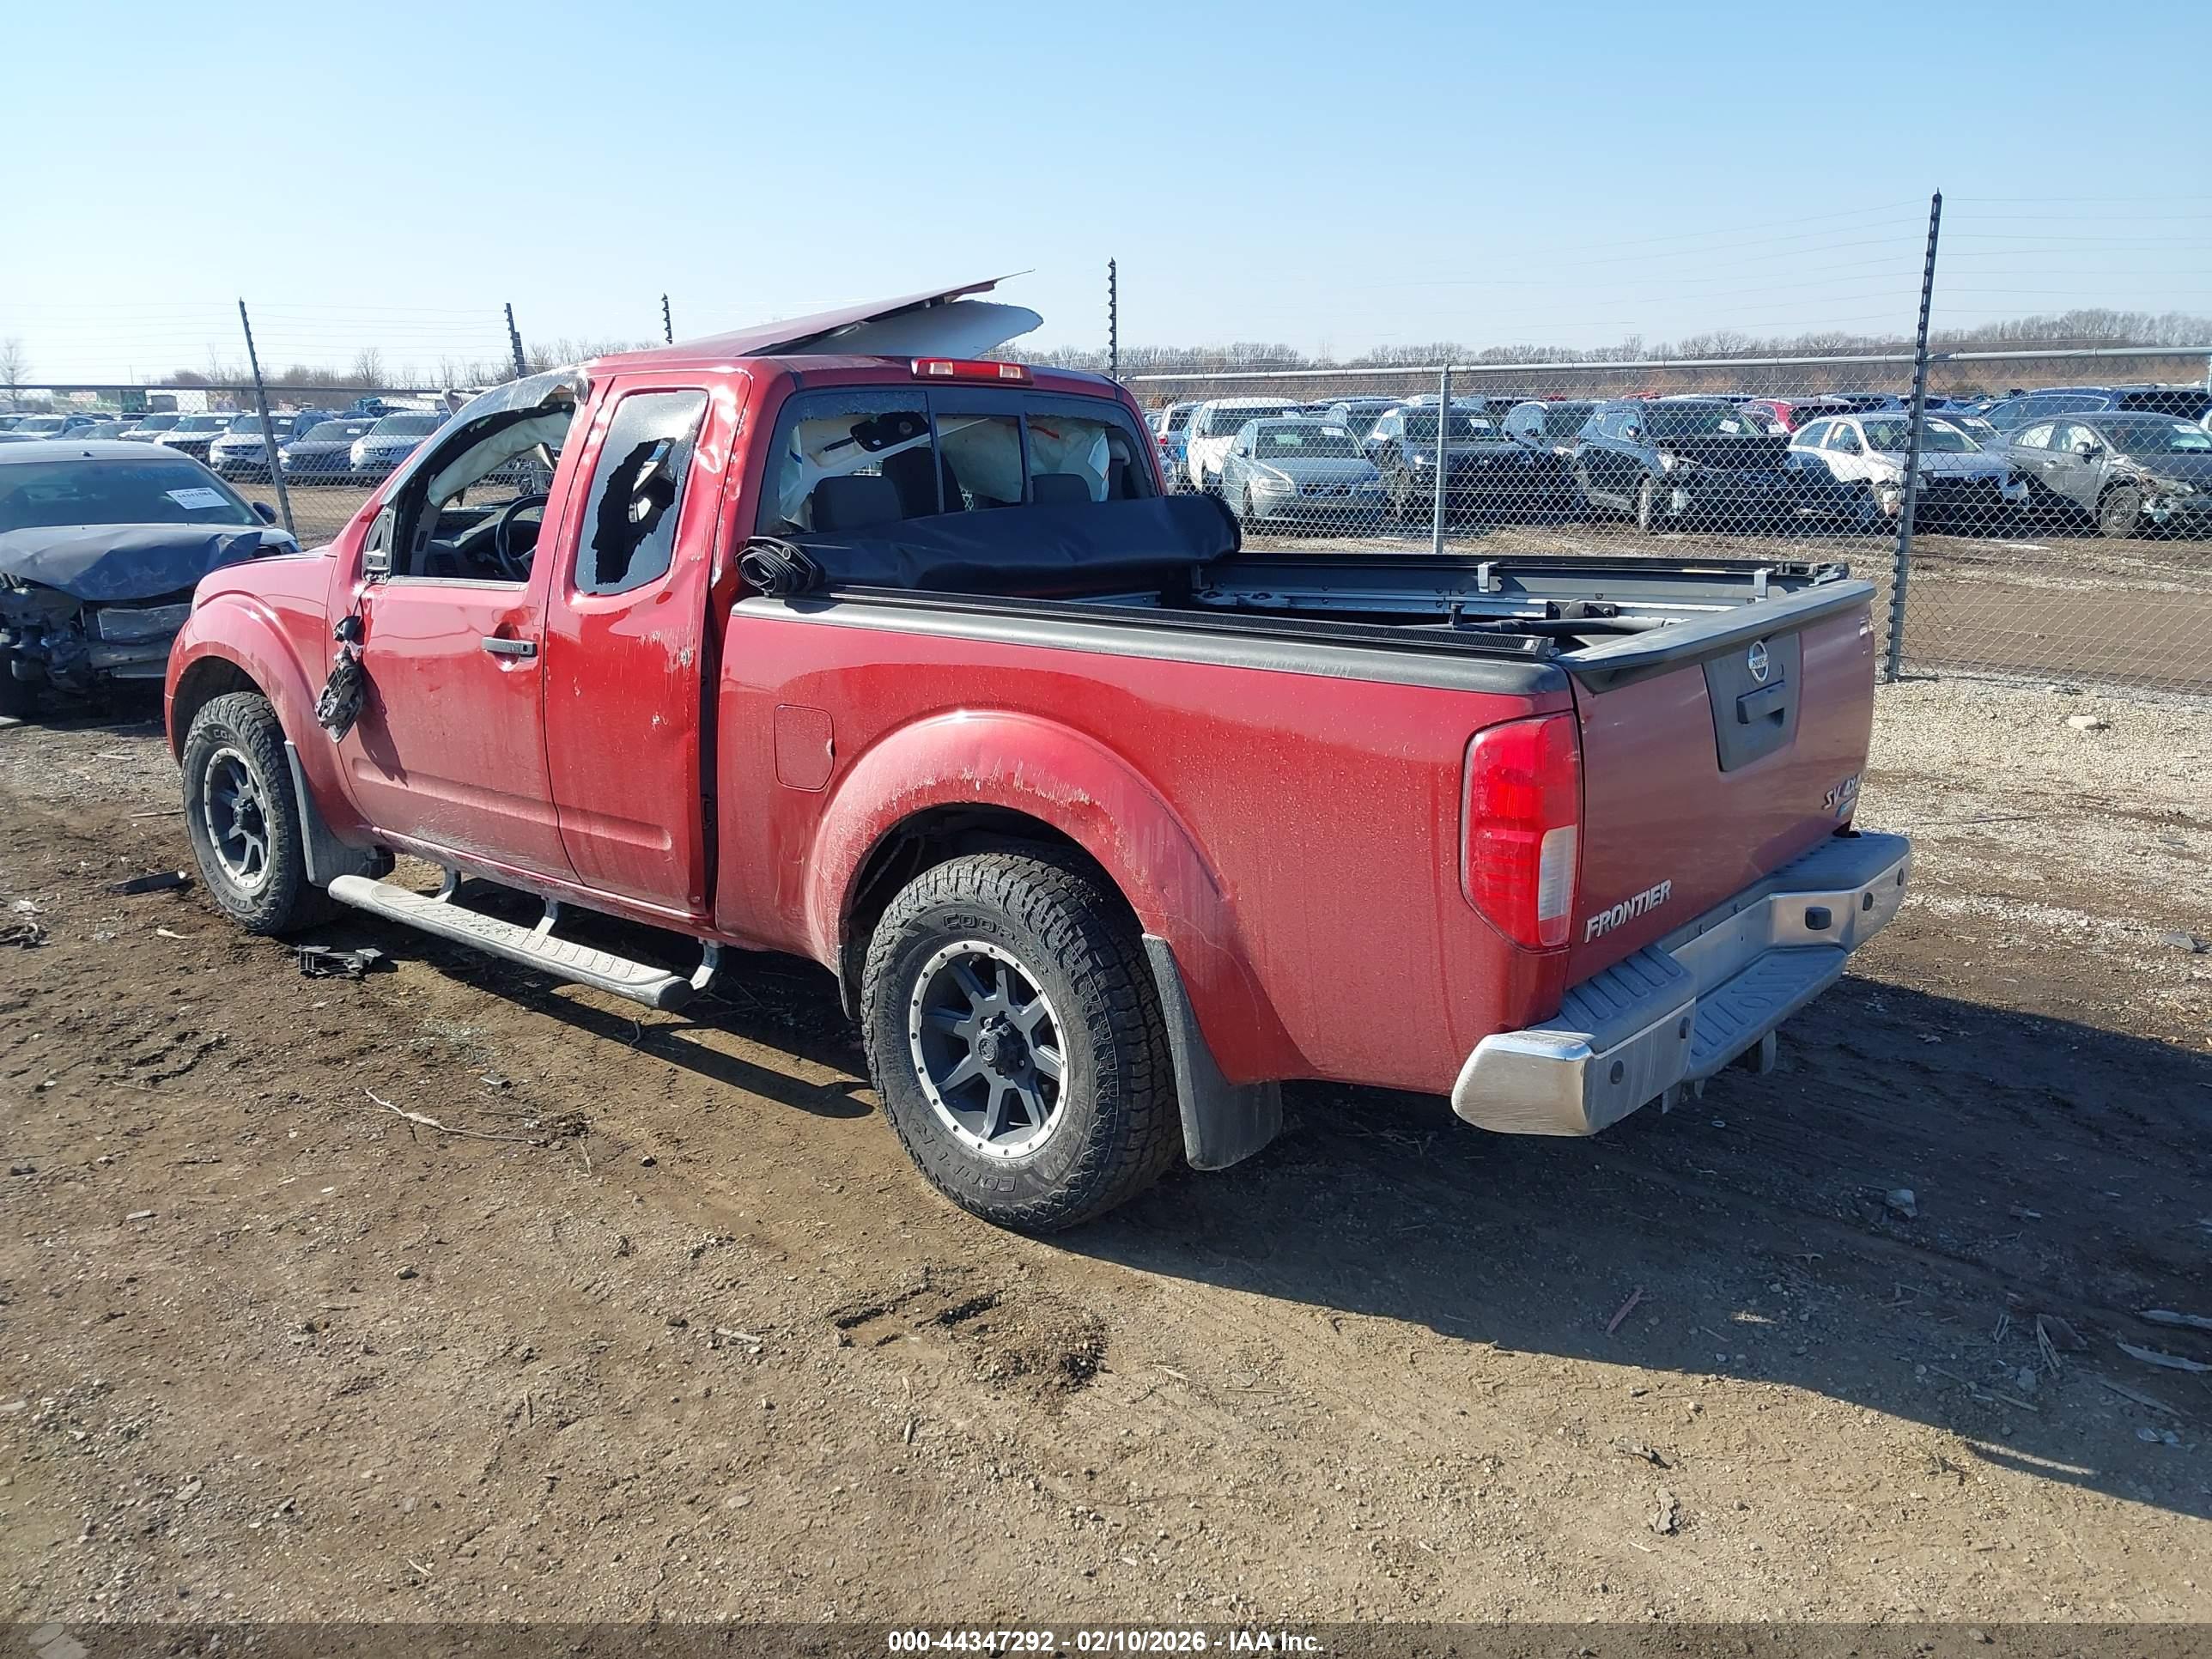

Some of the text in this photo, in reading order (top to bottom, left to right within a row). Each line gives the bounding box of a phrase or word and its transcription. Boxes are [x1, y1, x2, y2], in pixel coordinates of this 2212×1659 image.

[1821, 785, 1842, 811] SV
[1583, 878, 1672, 944] FRONTIER
[943, 912, 1049, 977] COOPER
